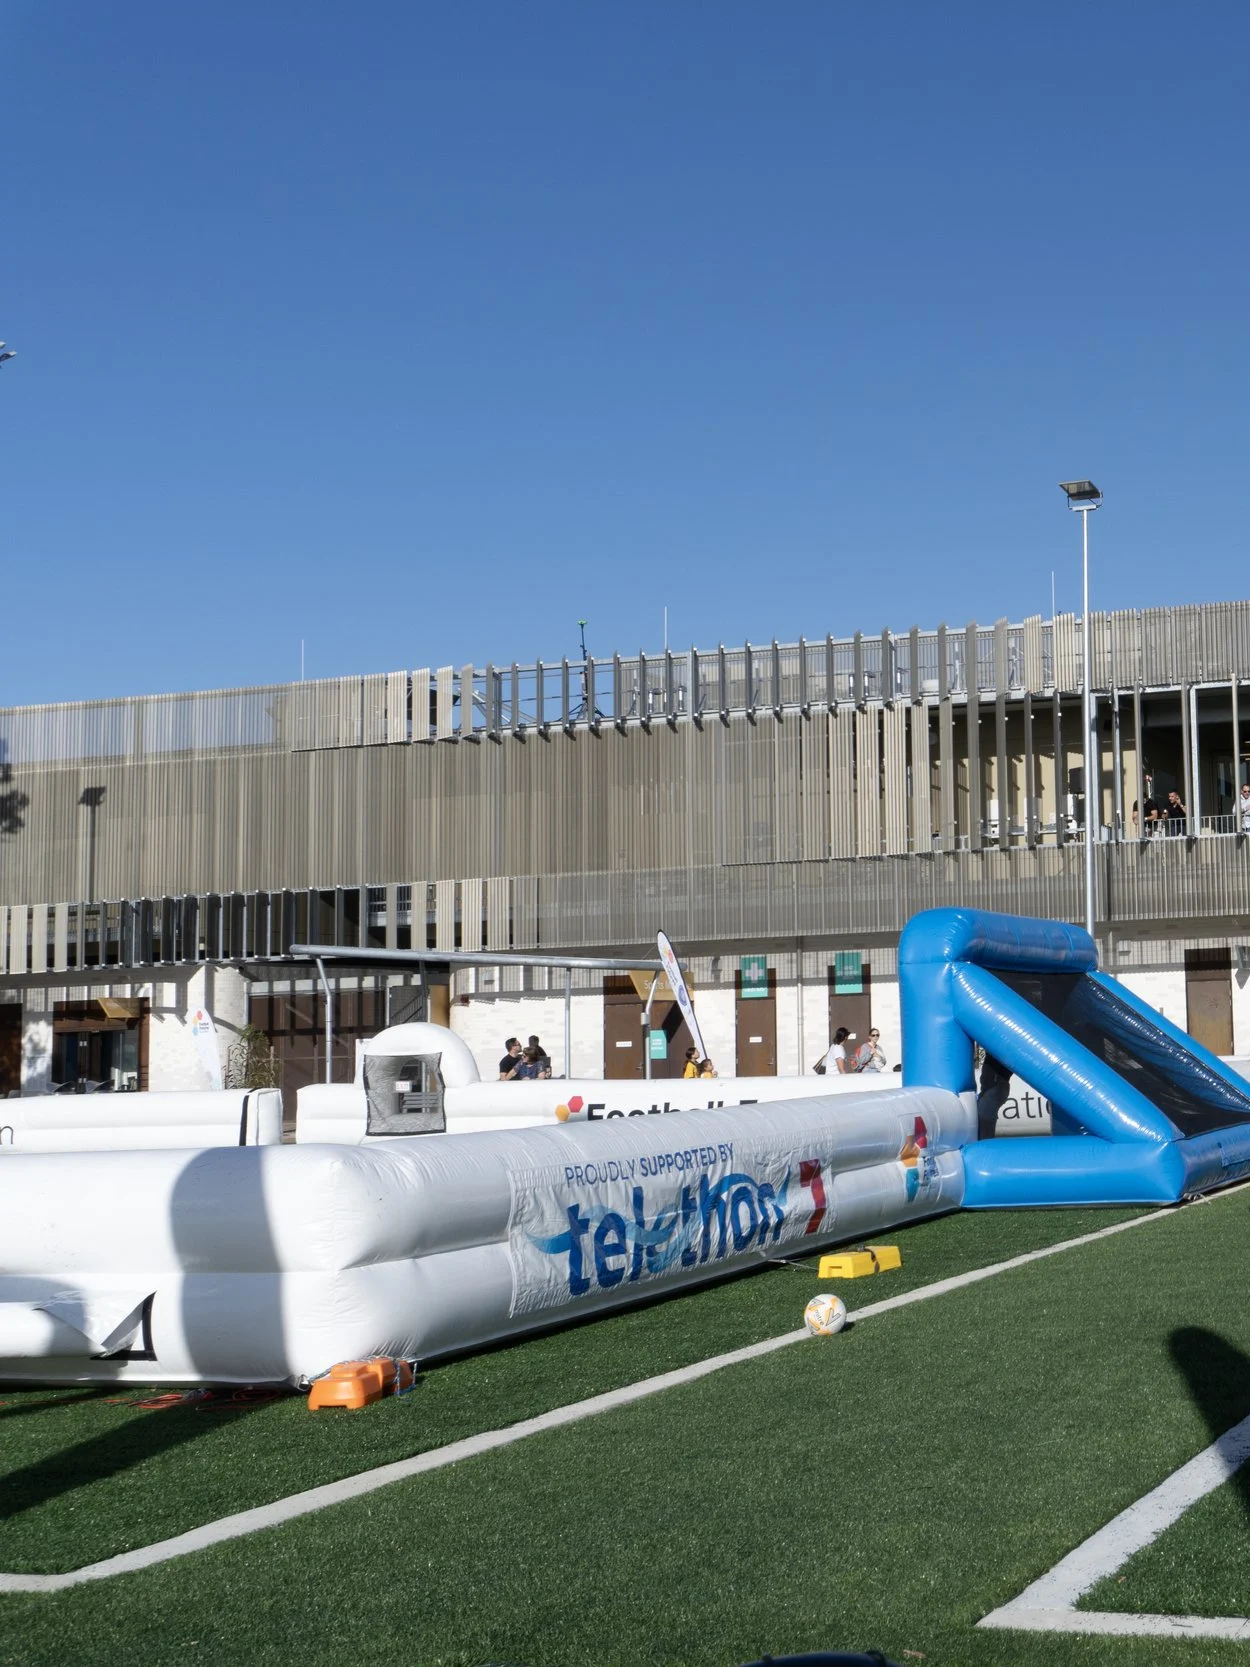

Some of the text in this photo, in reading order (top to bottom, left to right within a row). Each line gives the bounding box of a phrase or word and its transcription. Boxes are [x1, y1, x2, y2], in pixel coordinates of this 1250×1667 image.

[564, 1142, 734, 1188] PROUDLY SUPPORTED BY
[562, 1173, 788, 1296] telethon
